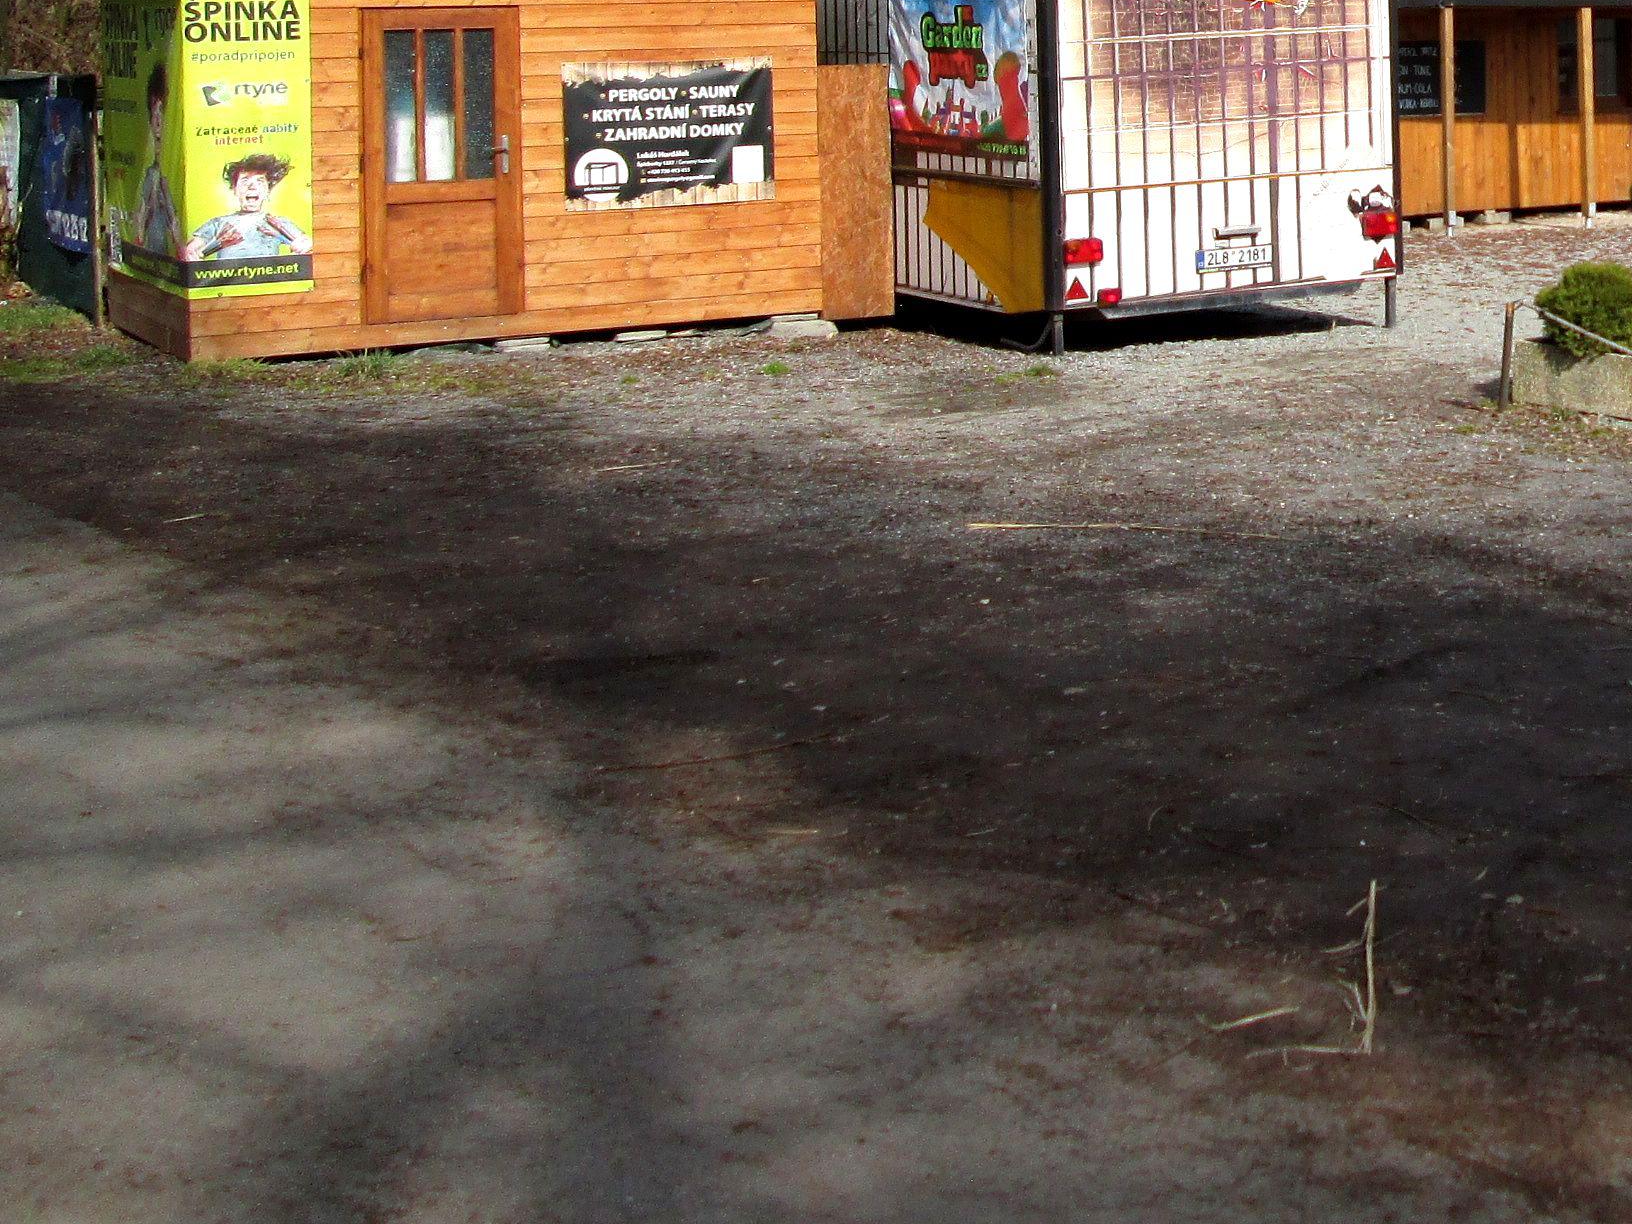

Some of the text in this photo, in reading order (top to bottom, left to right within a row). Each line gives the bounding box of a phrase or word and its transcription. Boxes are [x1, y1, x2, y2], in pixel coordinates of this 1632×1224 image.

[185, 21, 301, 43] ONLINE
[922, 5, 982, 48] Garden
[192, 49, 295, 64] #poradpripojen
[608, 84, 740, 102] PERGOLY SAUNY
[592, 103, 755, 122] KRYTÁ STÁNÍ TERASY
[215, 134, 264, 145] internet
[604, 123, 745, 142] ZAHRADNÍ DOMKY
[1208, 248, 1266, 266] 2L8 2181
[195, 262, 299, 279] www.rtyne.net
